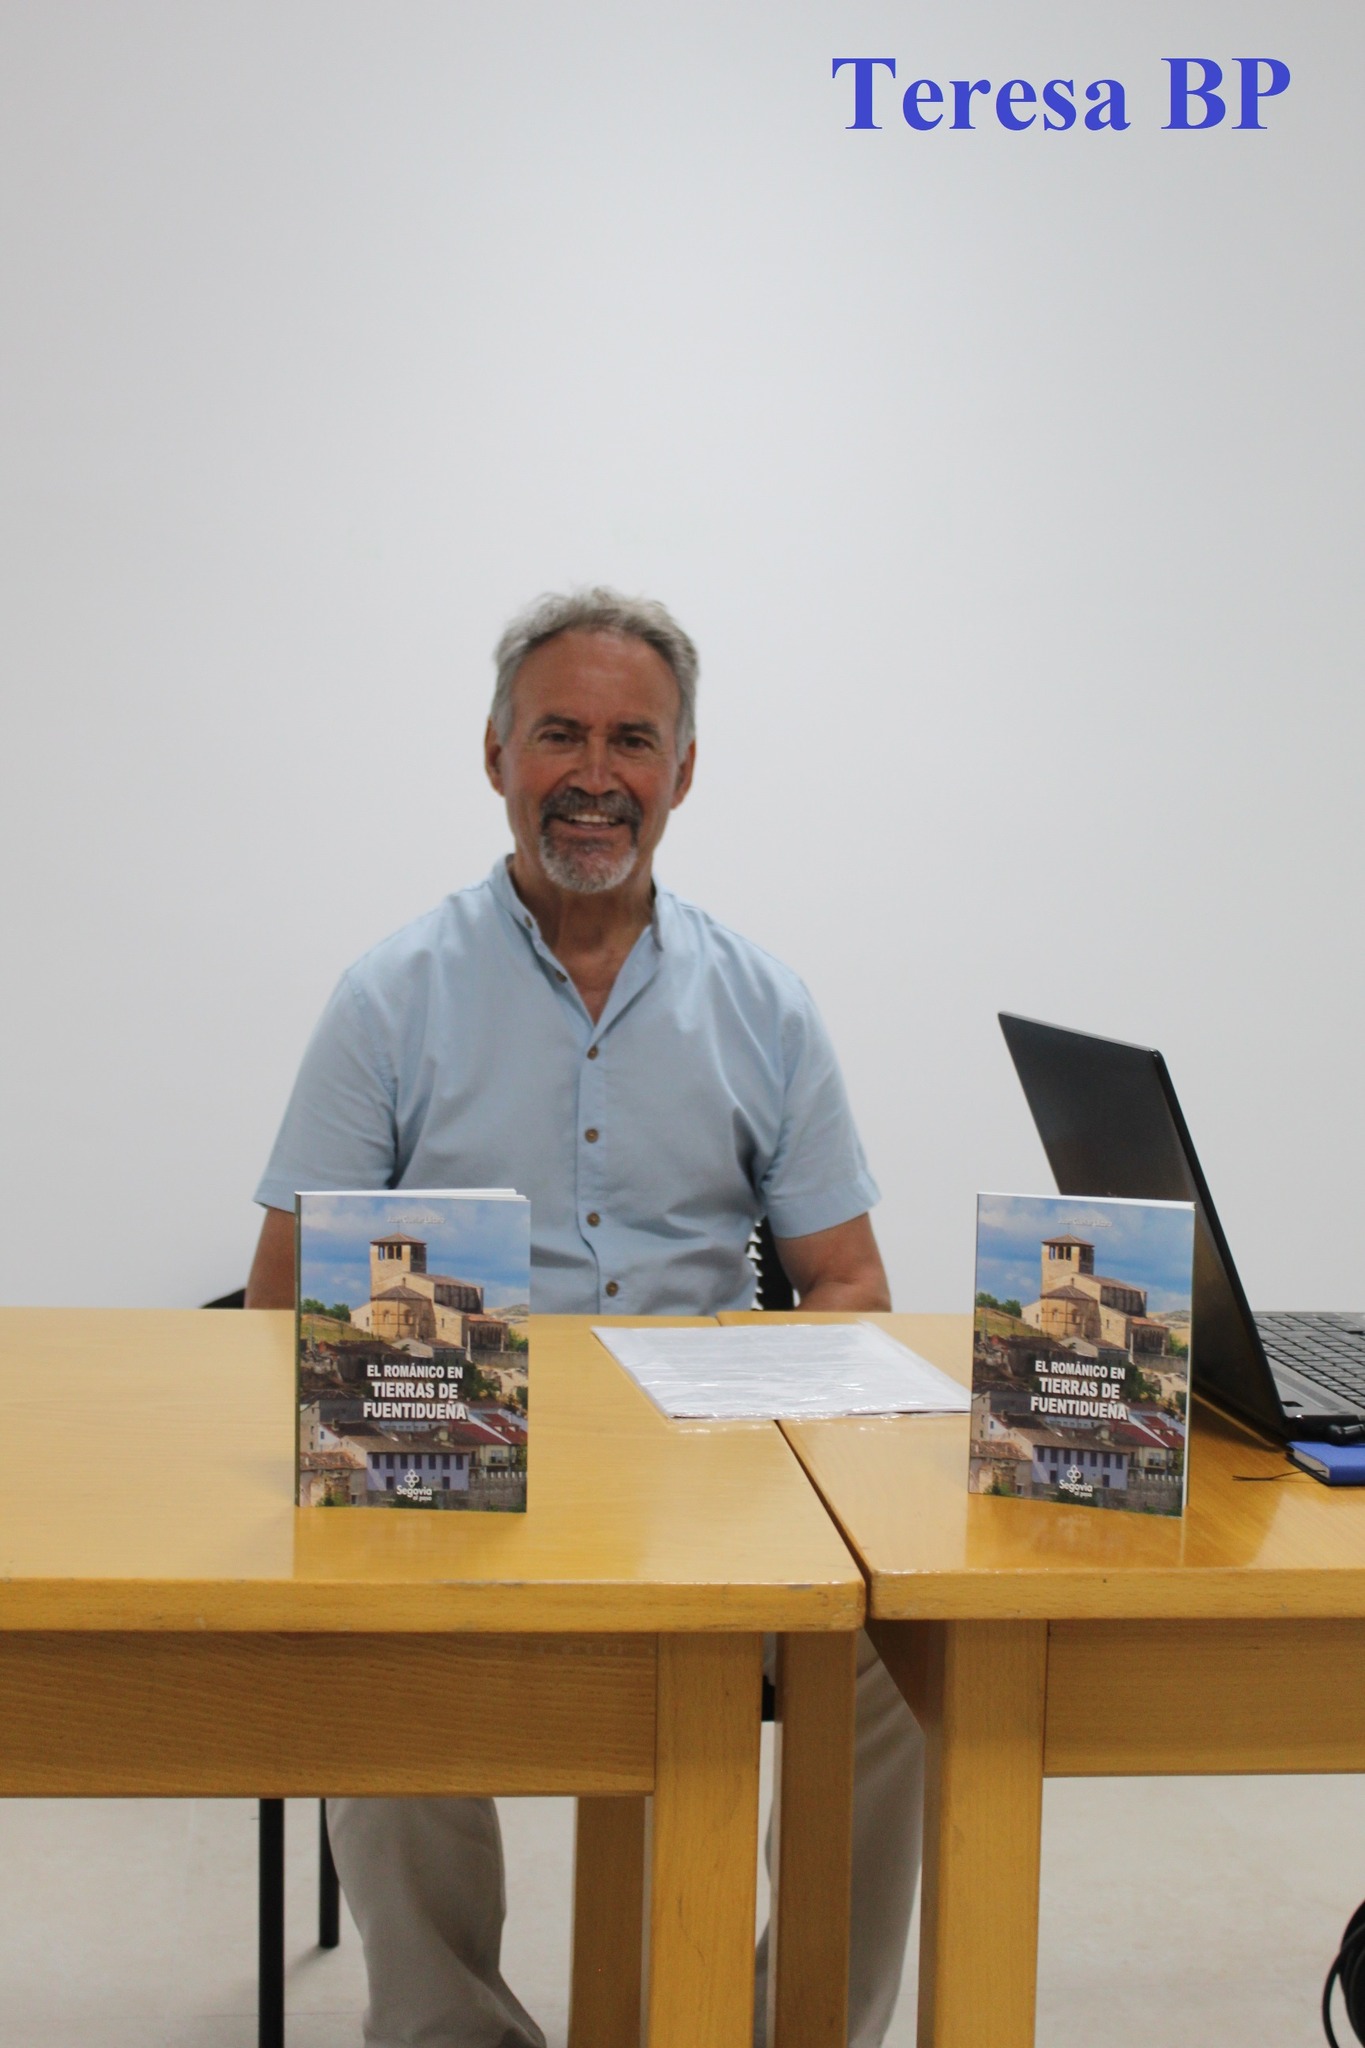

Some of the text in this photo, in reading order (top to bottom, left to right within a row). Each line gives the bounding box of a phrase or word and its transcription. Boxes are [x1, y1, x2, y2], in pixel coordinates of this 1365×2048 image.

[366, 1363, 463, 1379] EL ROMÁNICO EN
[1035, 1360, 1126, 1380] EL ROMÁNICO EN
[371, 1382, 458, 1399] TIERRAS DE
[1039, 1377, 1120, 1399] TIERRAS DE
[363, 1400, 467, 1419] FUENTIDUEÑA
[1030, 1396, 1128, 1420] FUENTIDUEÑA
[396, 1485, 432, 1498] Segovia
[1059, 1479, 1093, 1493] Segovia
